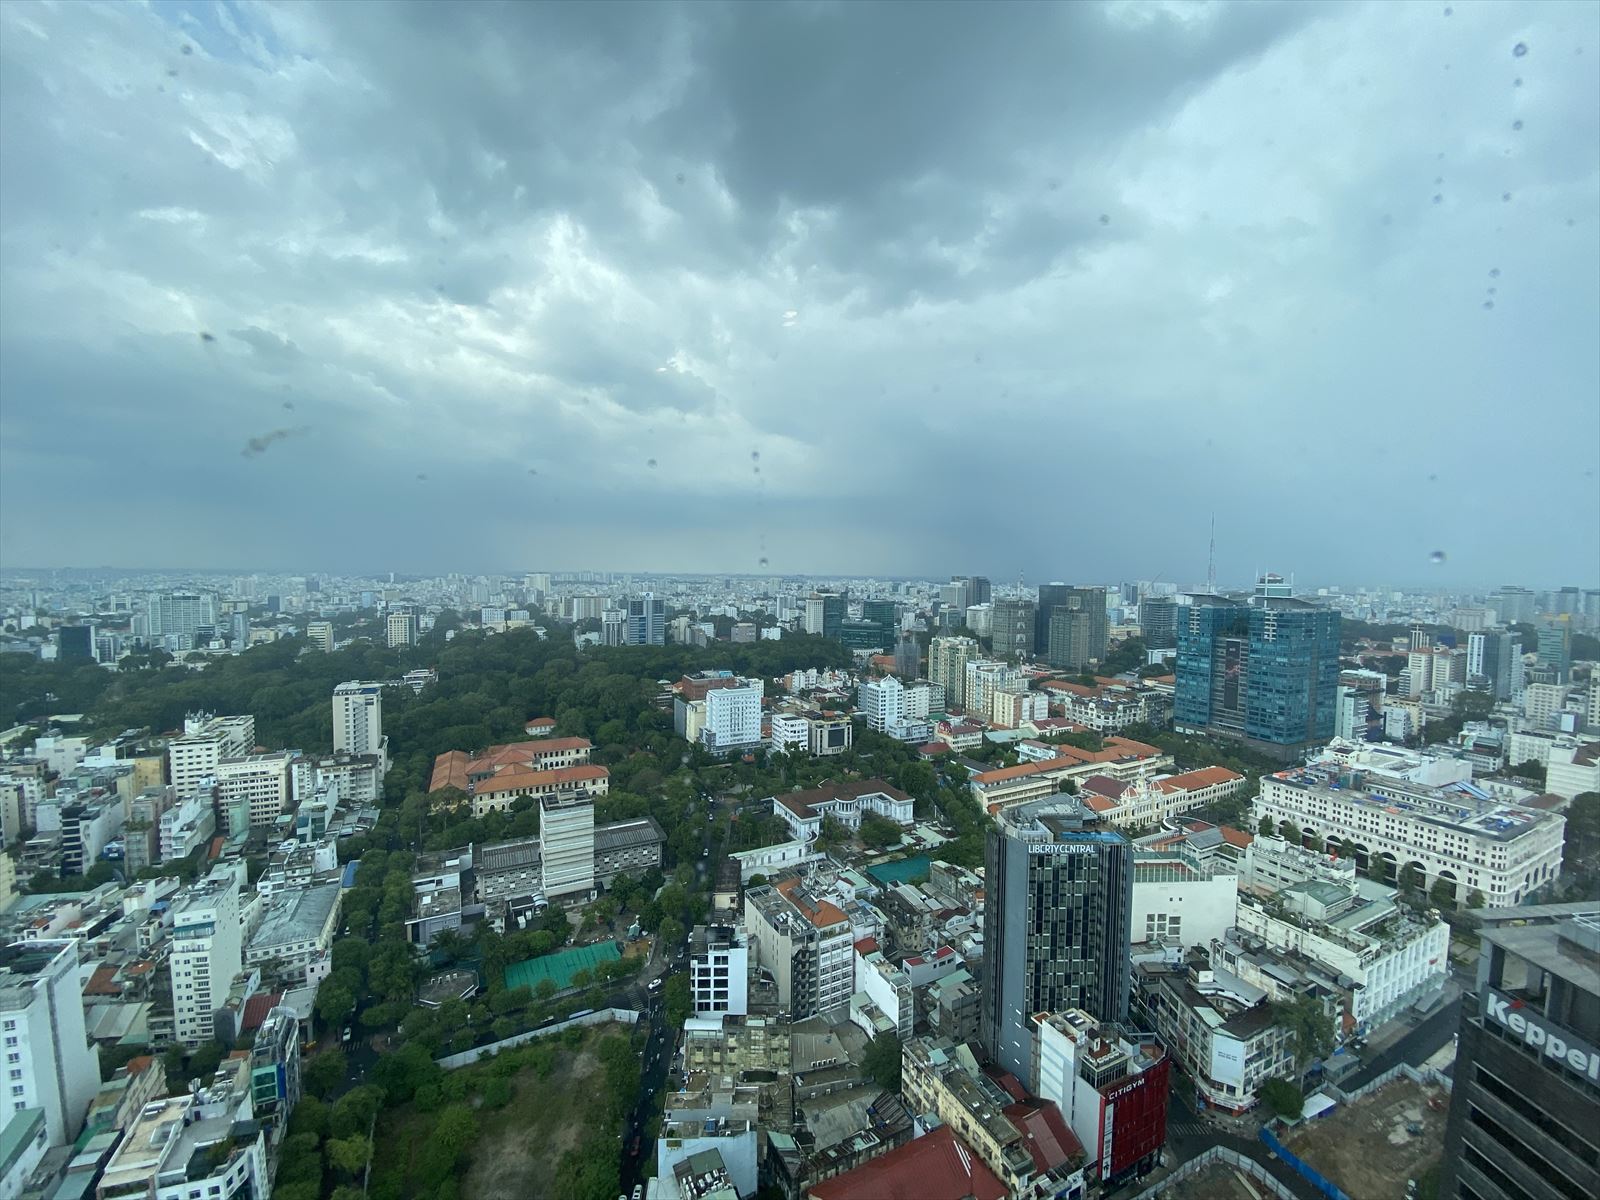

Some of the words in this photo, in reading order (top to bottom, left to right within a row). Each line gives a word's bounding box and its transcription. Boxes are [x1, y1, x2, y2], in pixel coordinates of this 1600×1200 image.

[1028, 844, 1060, 854] LIBERTY
[1060, 844, 1096, 854] CENTRAL
[1486, 993, 1600, 1080] Keppel
[1108, 1078, 1145, 1100] CITIGYM
